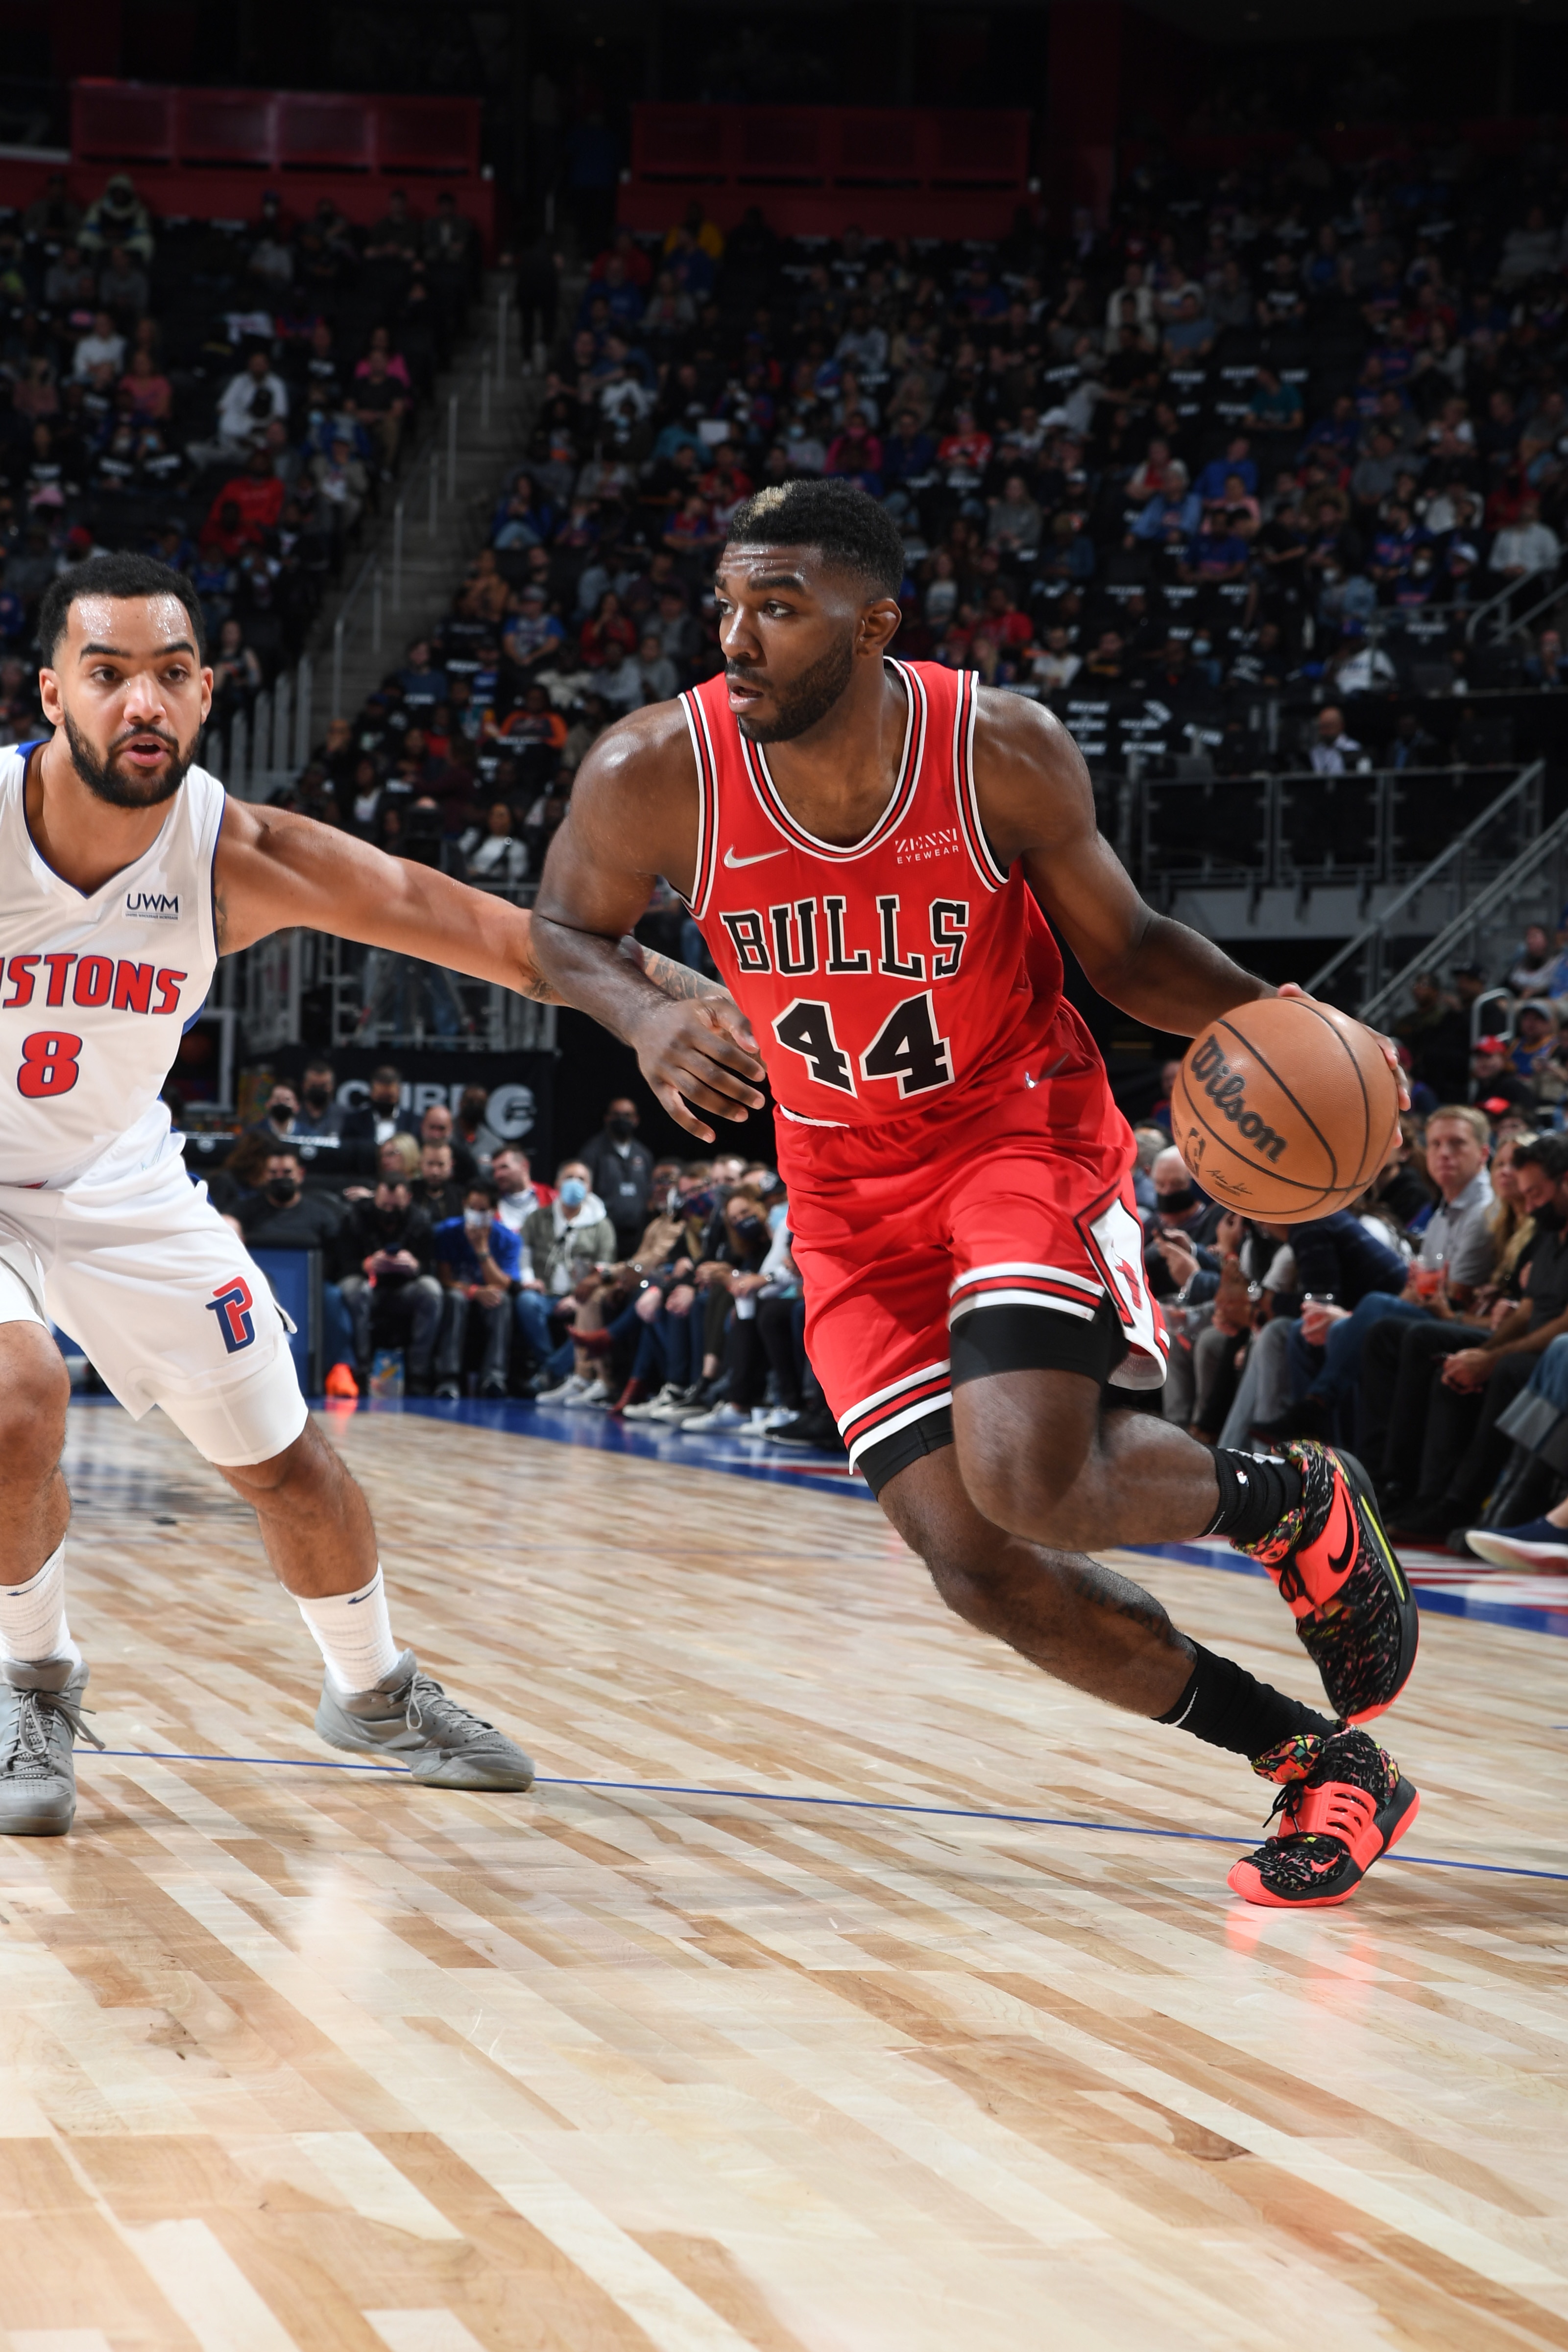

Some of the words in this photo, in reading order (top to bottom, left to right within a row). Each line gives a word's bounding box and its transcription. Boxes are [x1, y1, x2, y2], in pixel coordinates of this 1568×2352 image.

[895, 828, 958, 853] ZENNI
[897, 845, 959, 864] EYEWEAR
[126, 893, 178, 913] UWM
[719, 894, 969, 982] BULLS
[0, 953, 188, 1015] STONS
[17, 1031, 83, 1098] 8
[771, 988, 955, 1100] 44
[1191, 1034, 1288, 1164] Wilson
